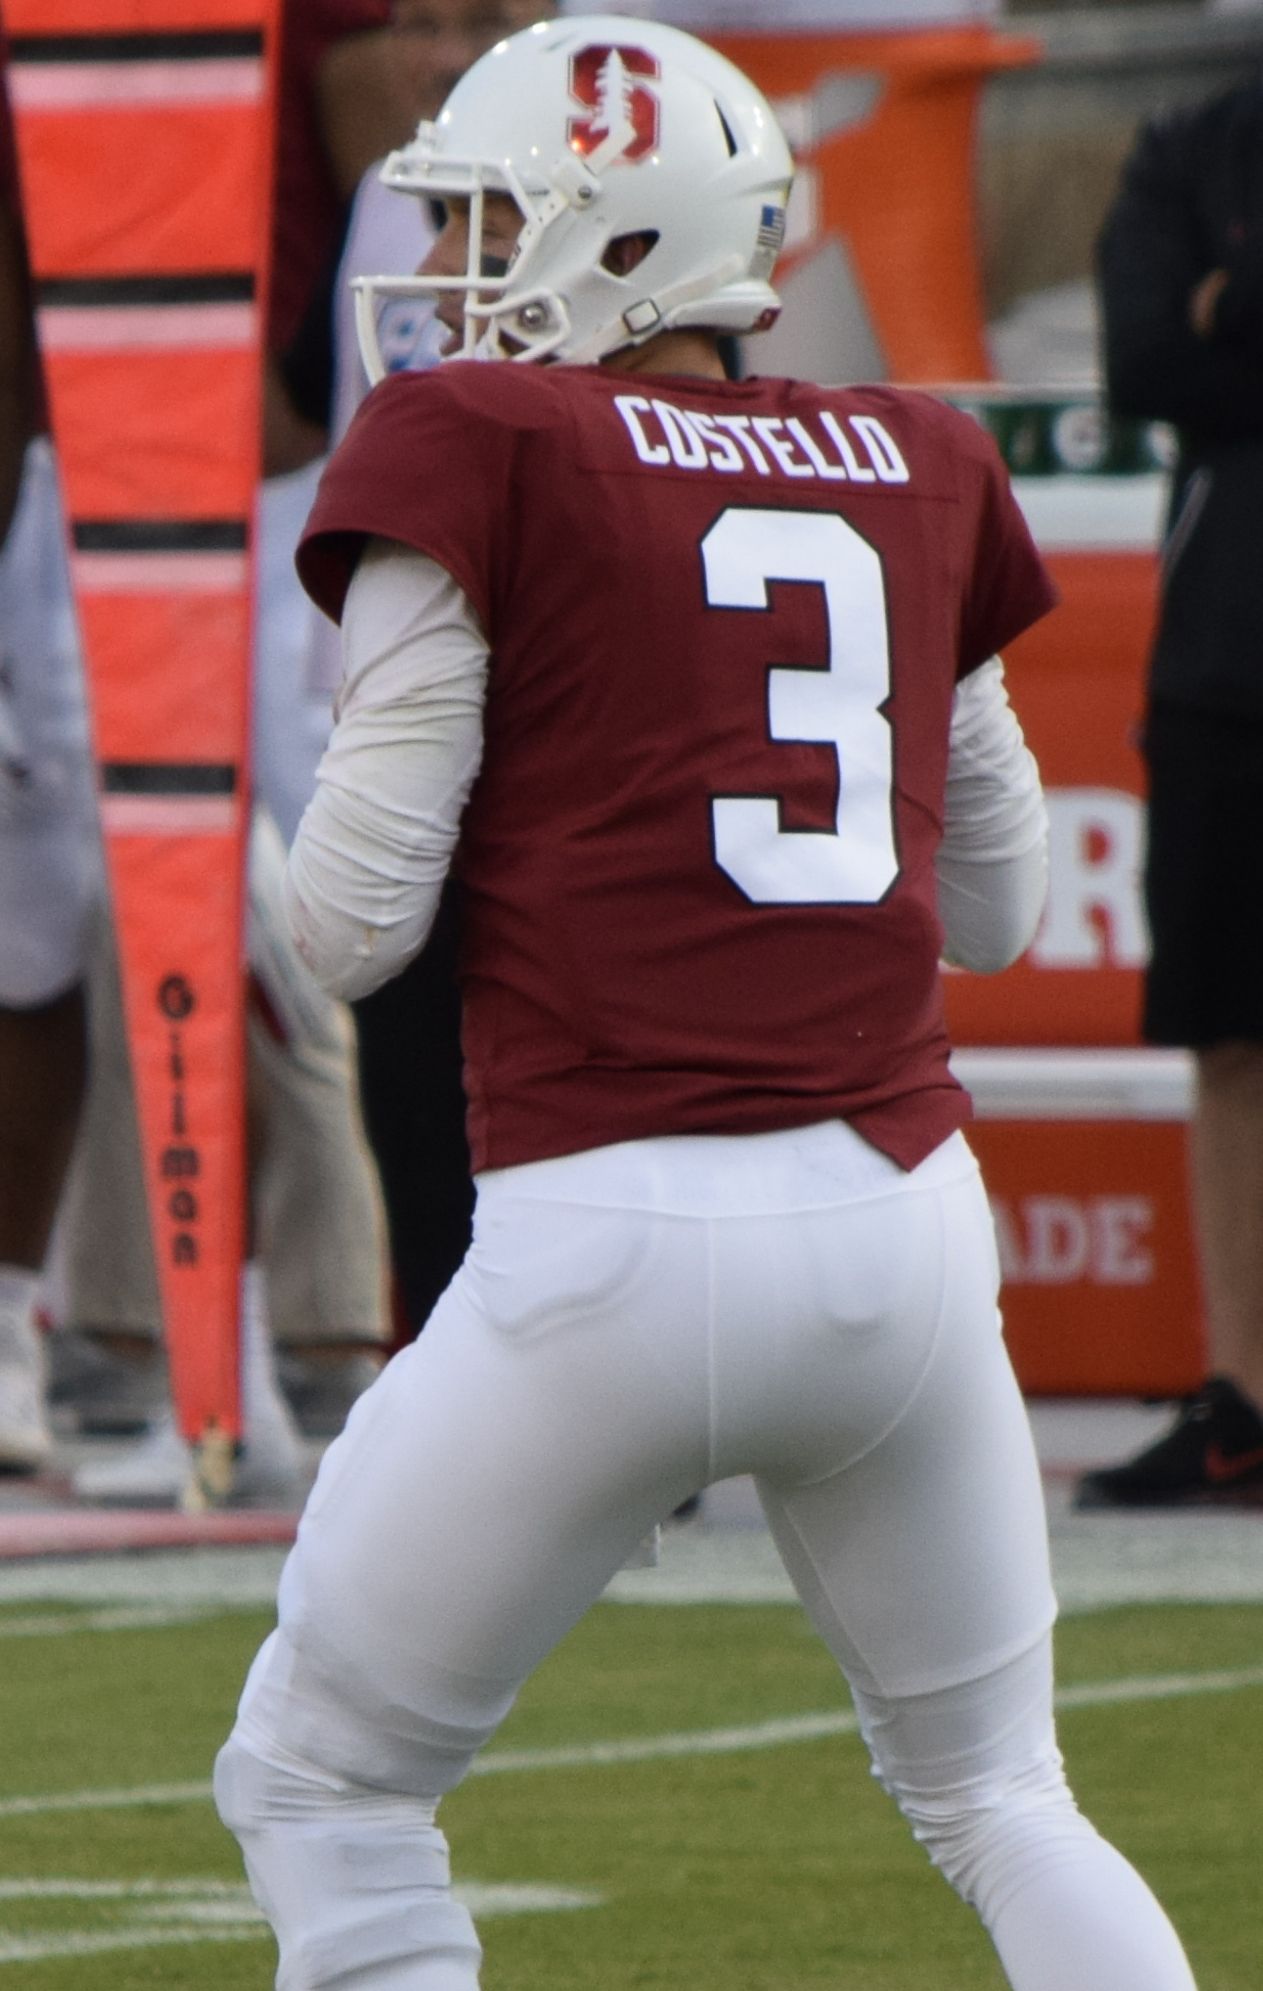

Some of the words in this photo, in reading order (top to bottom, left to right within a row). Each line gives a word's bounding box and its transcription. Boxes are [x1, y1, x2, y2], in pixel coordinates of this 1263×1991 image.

[613, 395, 911, 483] COSTELLO
[700, 505, 902, 906] 3
[155, 969, 203, 1269] Gilman
